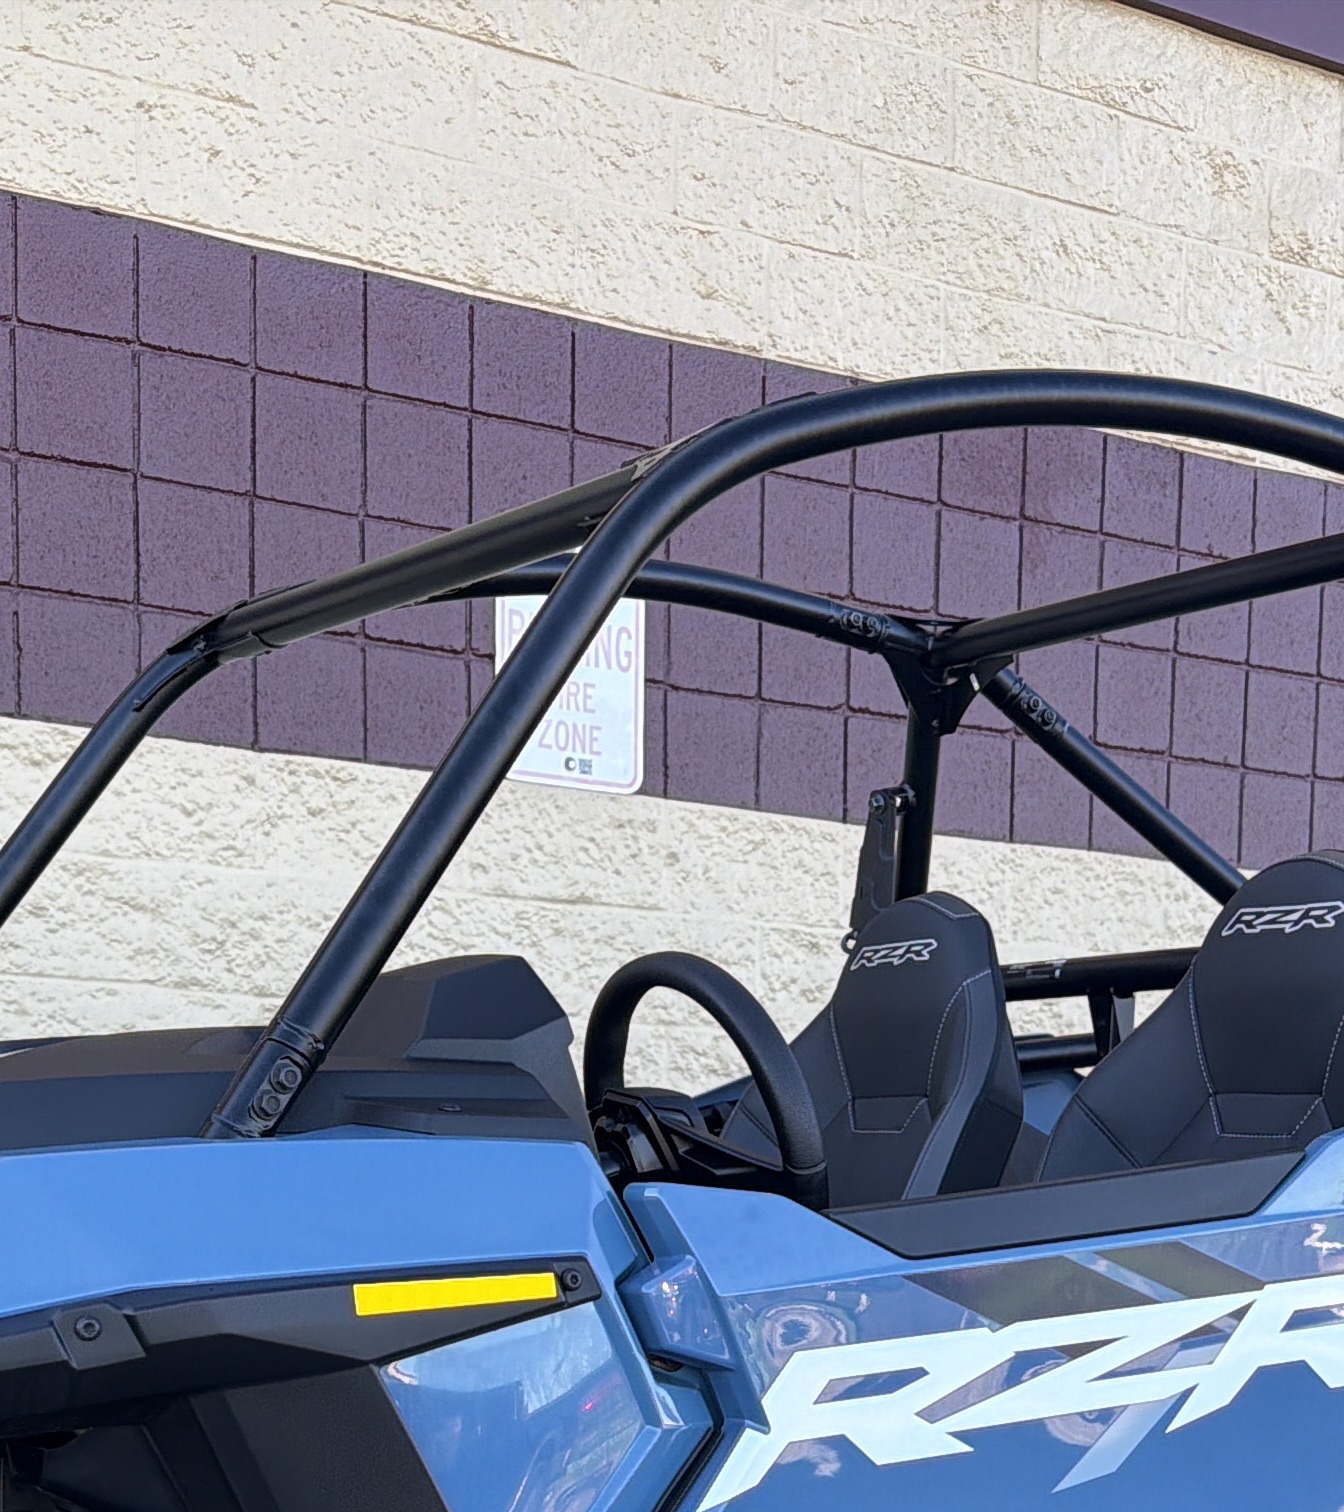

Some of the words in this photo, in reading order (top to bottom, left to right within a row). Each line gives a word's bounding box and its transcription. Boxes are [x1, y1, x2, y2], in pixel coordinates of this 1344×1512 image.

[558, 680, 597, 714] IRE
[538, 718, 603, 756] ZONE
[850, 939, 938, 971] RZR
